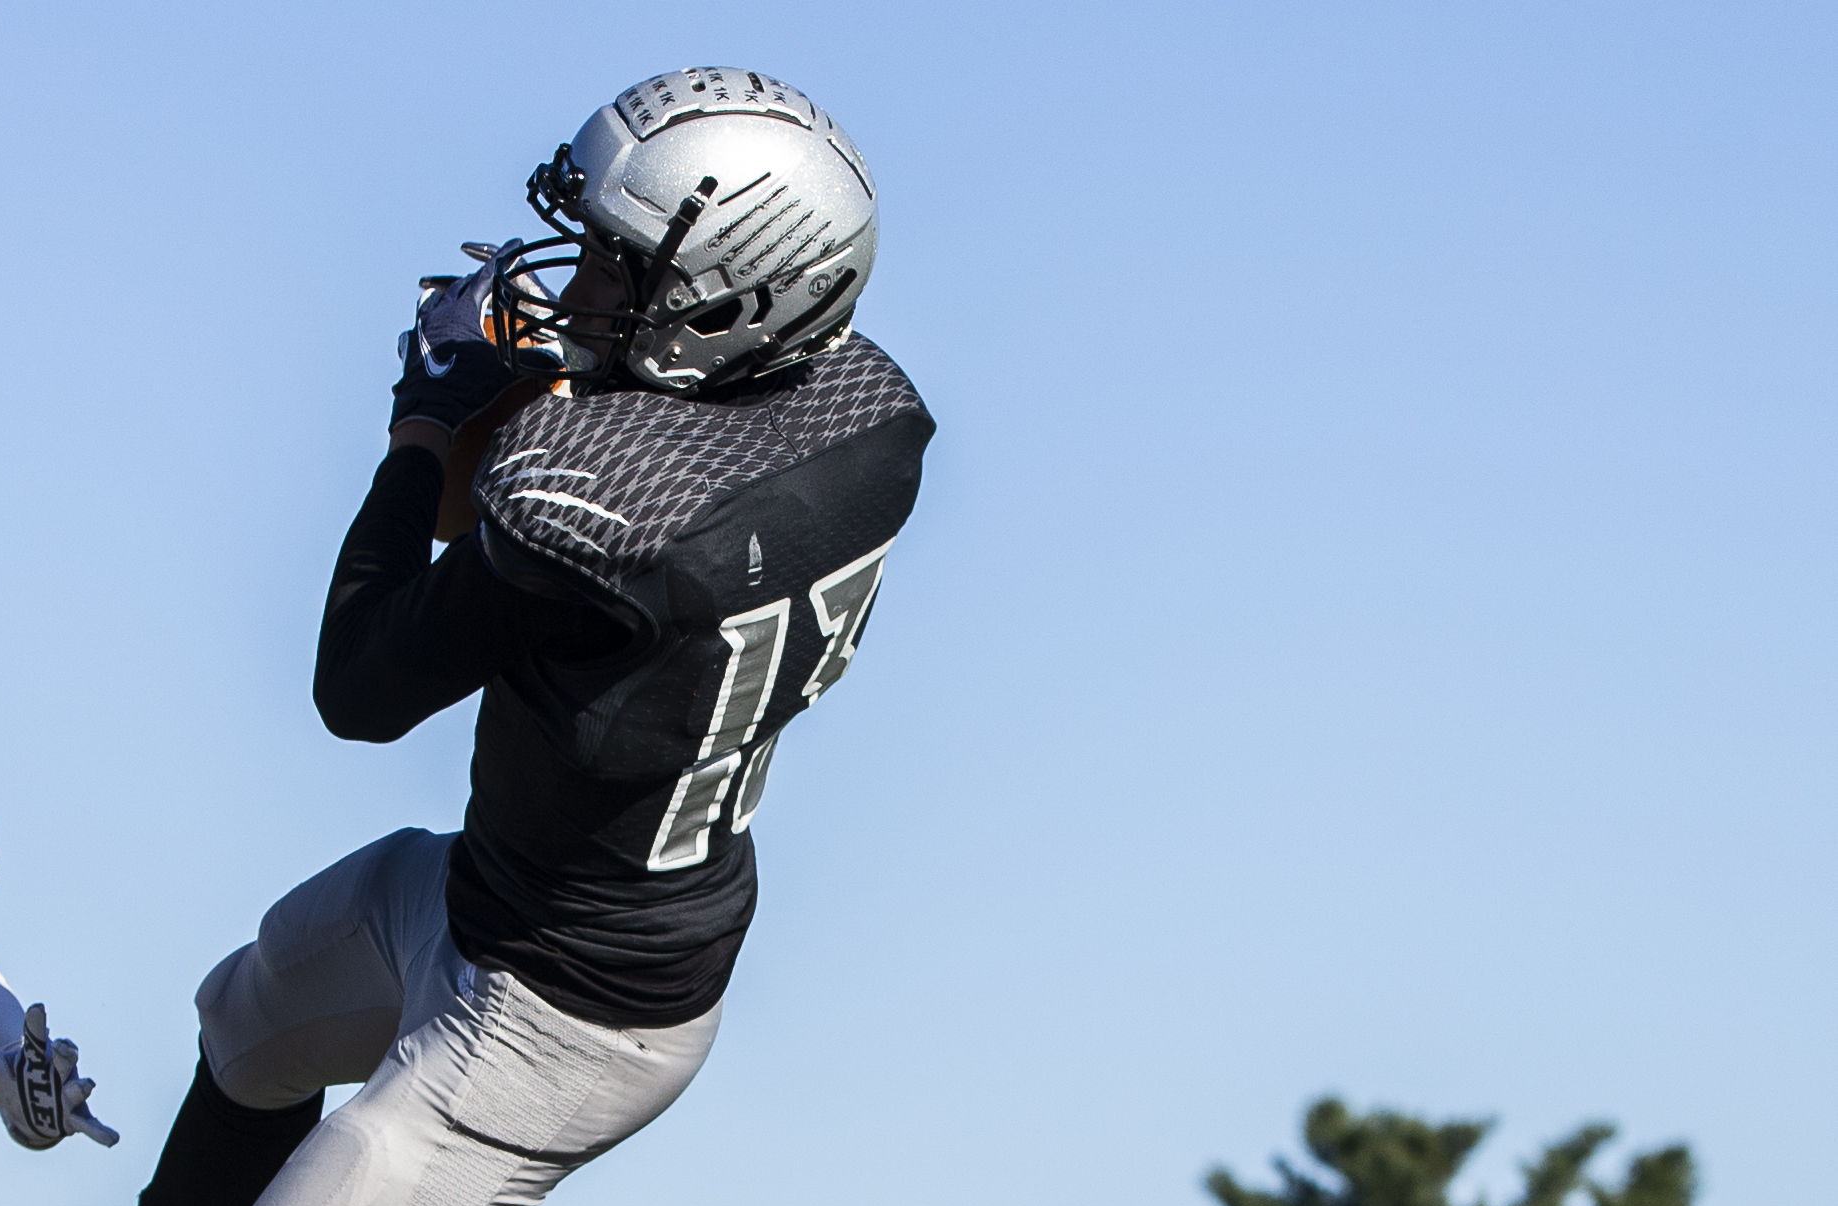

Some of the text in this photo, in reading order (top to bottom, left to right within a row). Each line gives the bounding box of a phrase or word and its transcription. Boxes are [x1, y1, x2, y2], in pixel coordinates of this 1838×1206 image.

[659, 91, 676, 107] 1K
[713, 87, 730, 101] 1K
[744, 90, 759, 103] 1K
[773, 90, 787, 104] 1K
[629, 96, 645, 111] 1K
[637, 109, 655, 127] 1K
